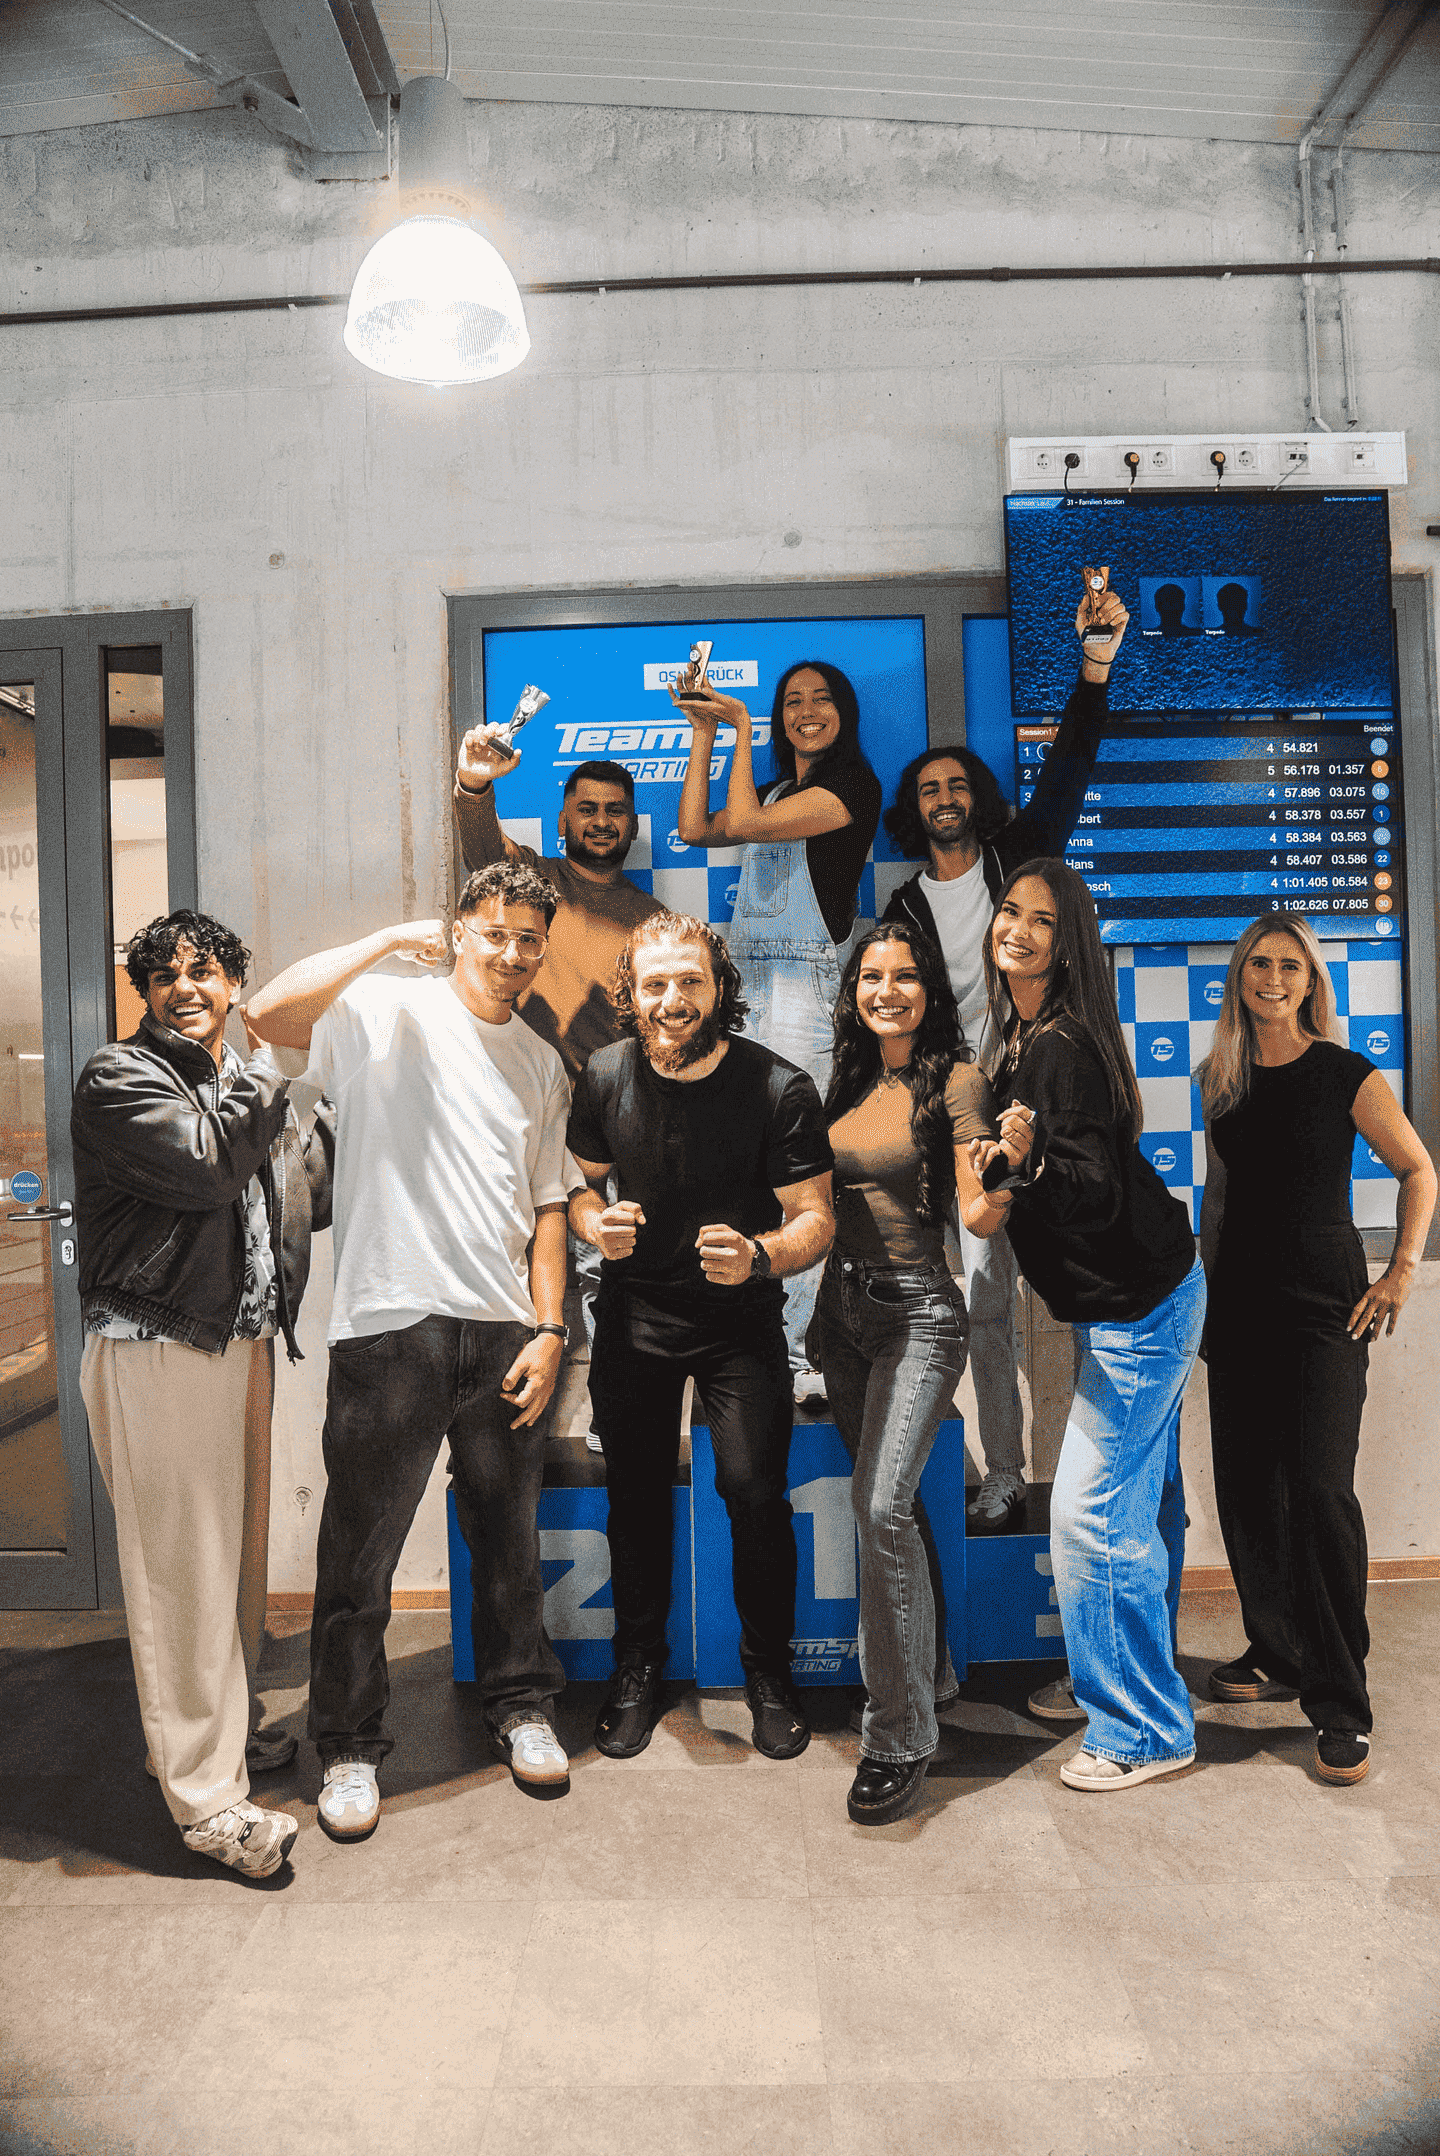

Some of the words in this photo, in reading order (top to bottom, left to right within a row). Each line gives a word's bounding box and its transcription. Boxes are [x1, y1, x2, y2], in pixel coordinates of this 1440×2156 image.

[1079, 498, 1103, 506] Familien
[658, 666, 744, 683] OSRÜCK
[1363, 724, 1394, 733] Beendet
[1023, 746, 1030, 757] 1
[1266, 743, 1275, 753] 4
[1283, 742, 1318, 753] 54.821
[1023, 769, 1032, 780] 2
[1267, 765, 1275, 775] 5
[1283, 764, 1320, 775] 56.178
[1328, 763, 1365, 775] 01.357
[1024, 792, 1032, 803] 3
[1268, 788, 1276, 798] 4
[1284, 787, 1321, 798] 57.896
[1329, 786, 1366, 797] 03.075
[1077, 813, 1102, 824] bert
[1269, 810, 1277, 821] 4
[1285, 809, 1321, 820] 58.378
[1330, 809, 1366, 820] 03.557
[1378, 810, 1384, 818] 1
[1269, 832, 1277, 843] 4
[1285, 832, 1322, 843] 58.384
[1330, 831, 1367, 842] 03.563
[1065, 859, 1094, 870] Hans
[1270, 855, 1278, 866] 4
[1286, 854, 1322, 866] 58.407
[1331, 854, 1368, 865] 03.586
[1377, 855, 1388, 863] 22
[1270, 877, 1278, 888] 4
[1283, 877, 1328, 888] 1:01.405
[1332, 876, 1368, 887] 06.584
[1271, 900, 1279, 911] 3
[1283, 899, 1329, 910] 1:02.626
[1332, 898, 1369, 910] 07.805
[1378, 899, 1389, 908] 30
[789, 1476, 858, 1600] 1
[538, 1529, 616, 1641] 2
